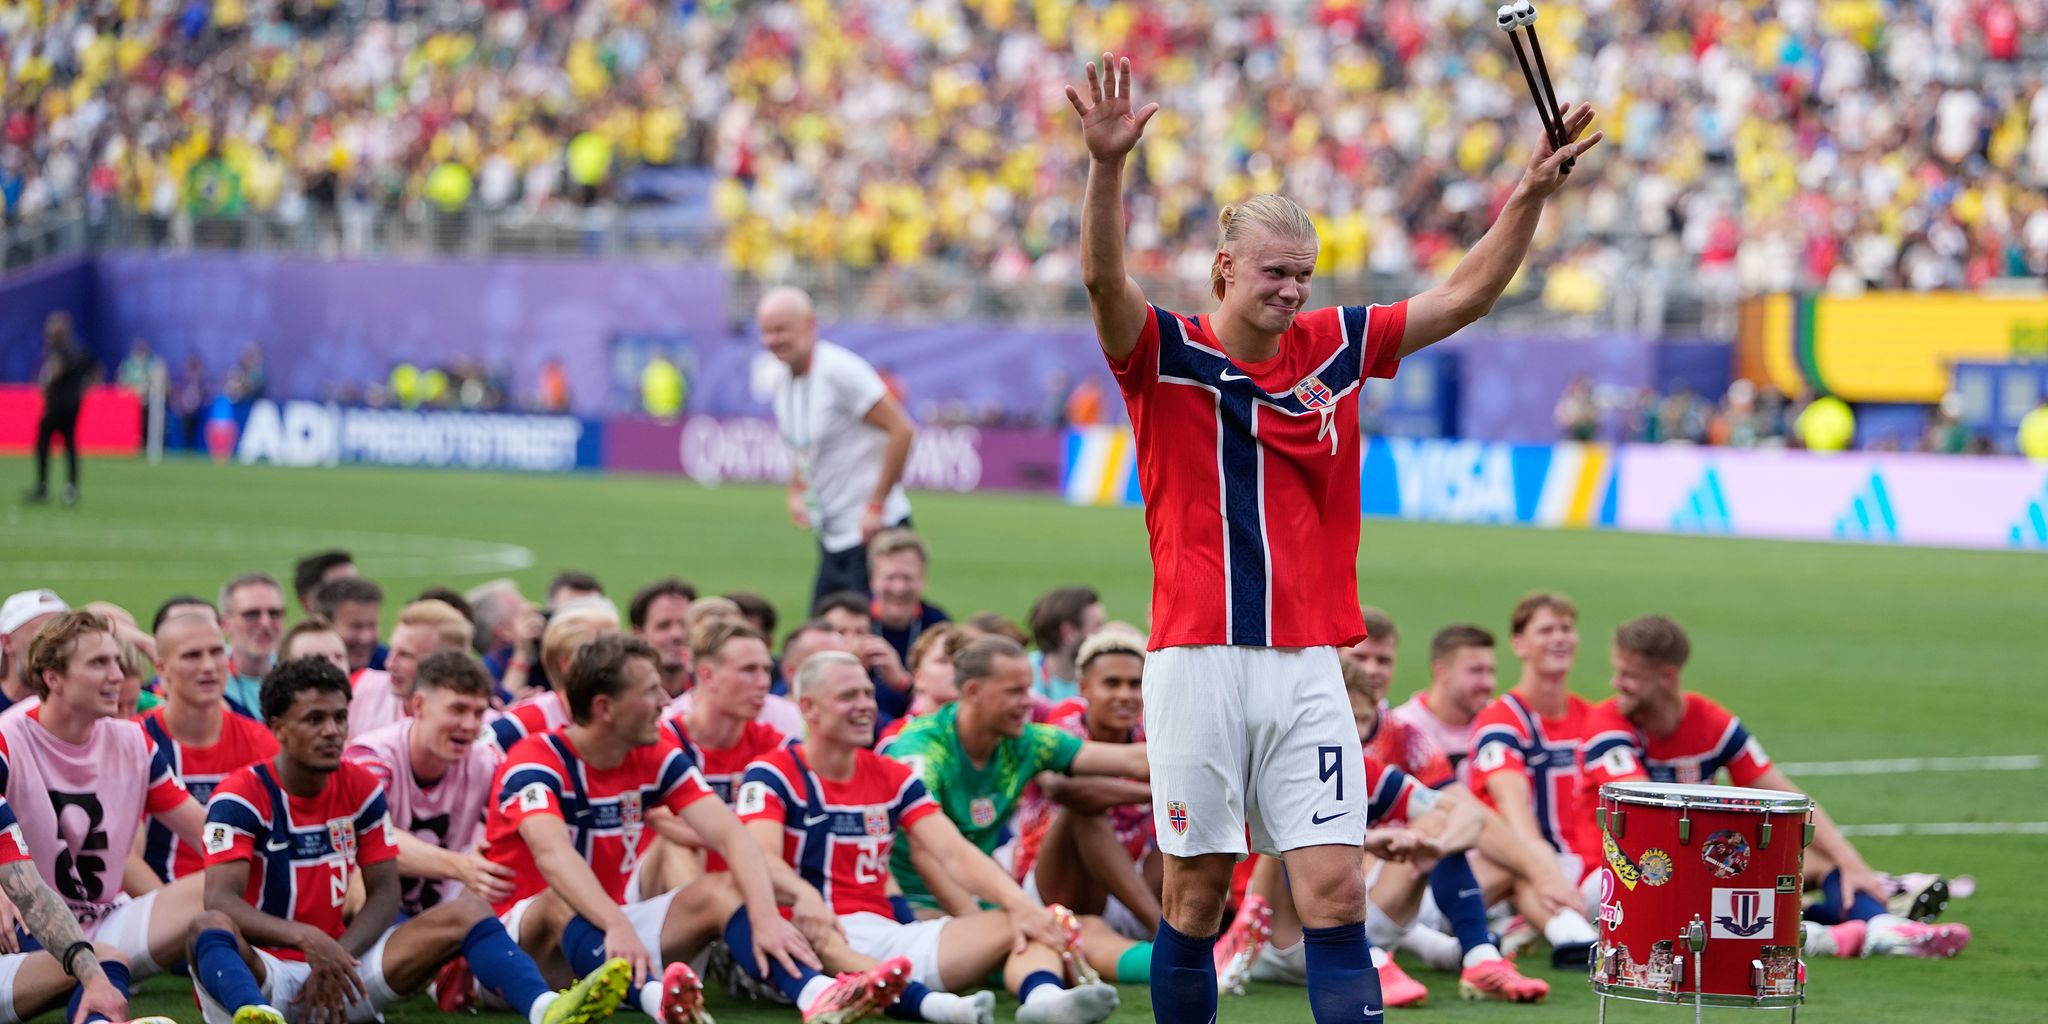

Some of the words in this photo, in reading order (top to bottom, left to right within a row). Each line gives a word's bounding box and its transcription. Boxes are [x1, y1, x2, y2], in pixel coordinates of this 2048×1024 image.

[1318, 405, 1338, 456] 9
[1386, 436, 1516, 522] VISA
[1317, 745, 1344, 801] 9
